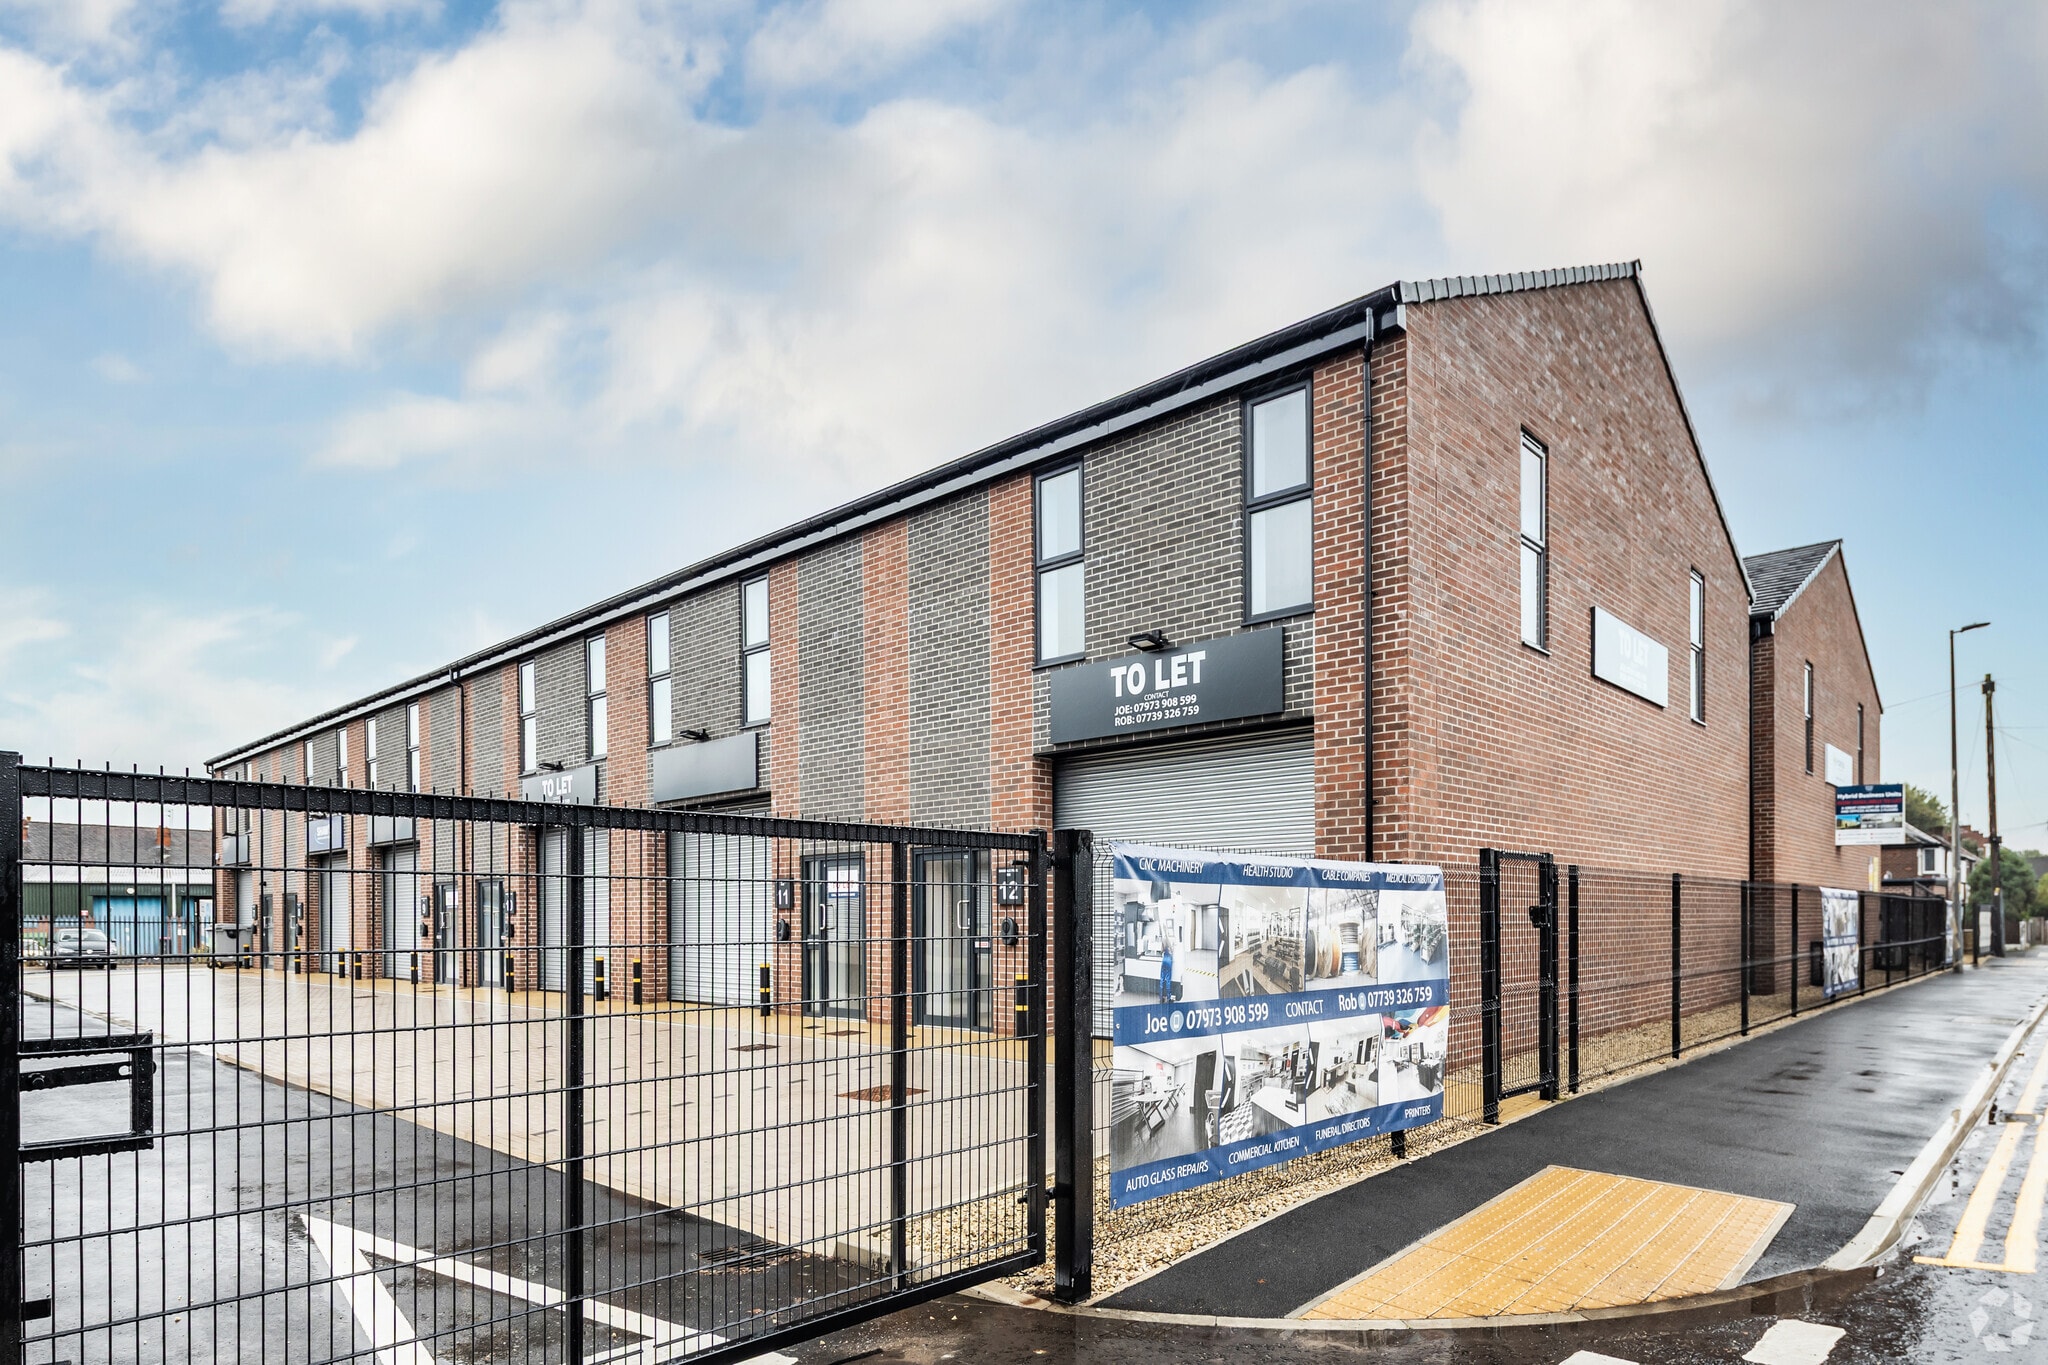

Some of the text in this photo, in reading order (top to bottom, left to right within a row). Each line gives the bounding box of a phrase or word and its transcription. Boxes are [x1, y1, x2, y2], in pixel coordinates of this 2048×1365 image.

[1111, 650, 1206, 698] TO LET
[1114, 694, 1197, 716] JOE: 07973 908 599
[1144, 690, 1169, 701] CONTACT
[1115, 705, 1200, 727] ROB: 07739 326 759
[542, 775, 573, 797] TO LET
[1139, 857, 1205, 874] CNC MACHINERY
[1243, 864, 1293, 879] HEALTH STUDIO
[1322, 869, 1371, 882] CABLE COMPANIES
[1385, 873, 1407, 884] MEDICAL
[778, 889, 788, 905] 11
[999, 880, 1019, 900] 12
[1286, 1000, 1324, 1018] CONTACT
[1339, 986, 1432, 1011] Rob 07739 326 759
[1145, 1002, 1269, 1034] Joe 07973 908 599
[1404, 1104, 1431, 1119] PRINTERS
[1315, 1117, 1371, 1140] FUNERAL DIRECTORS
[1228, 1136, 1300, 1165] COMMERCIAL KITCHEN
[1126, 1160, 1209, 1192] AUTO GLASS REPAIRS
